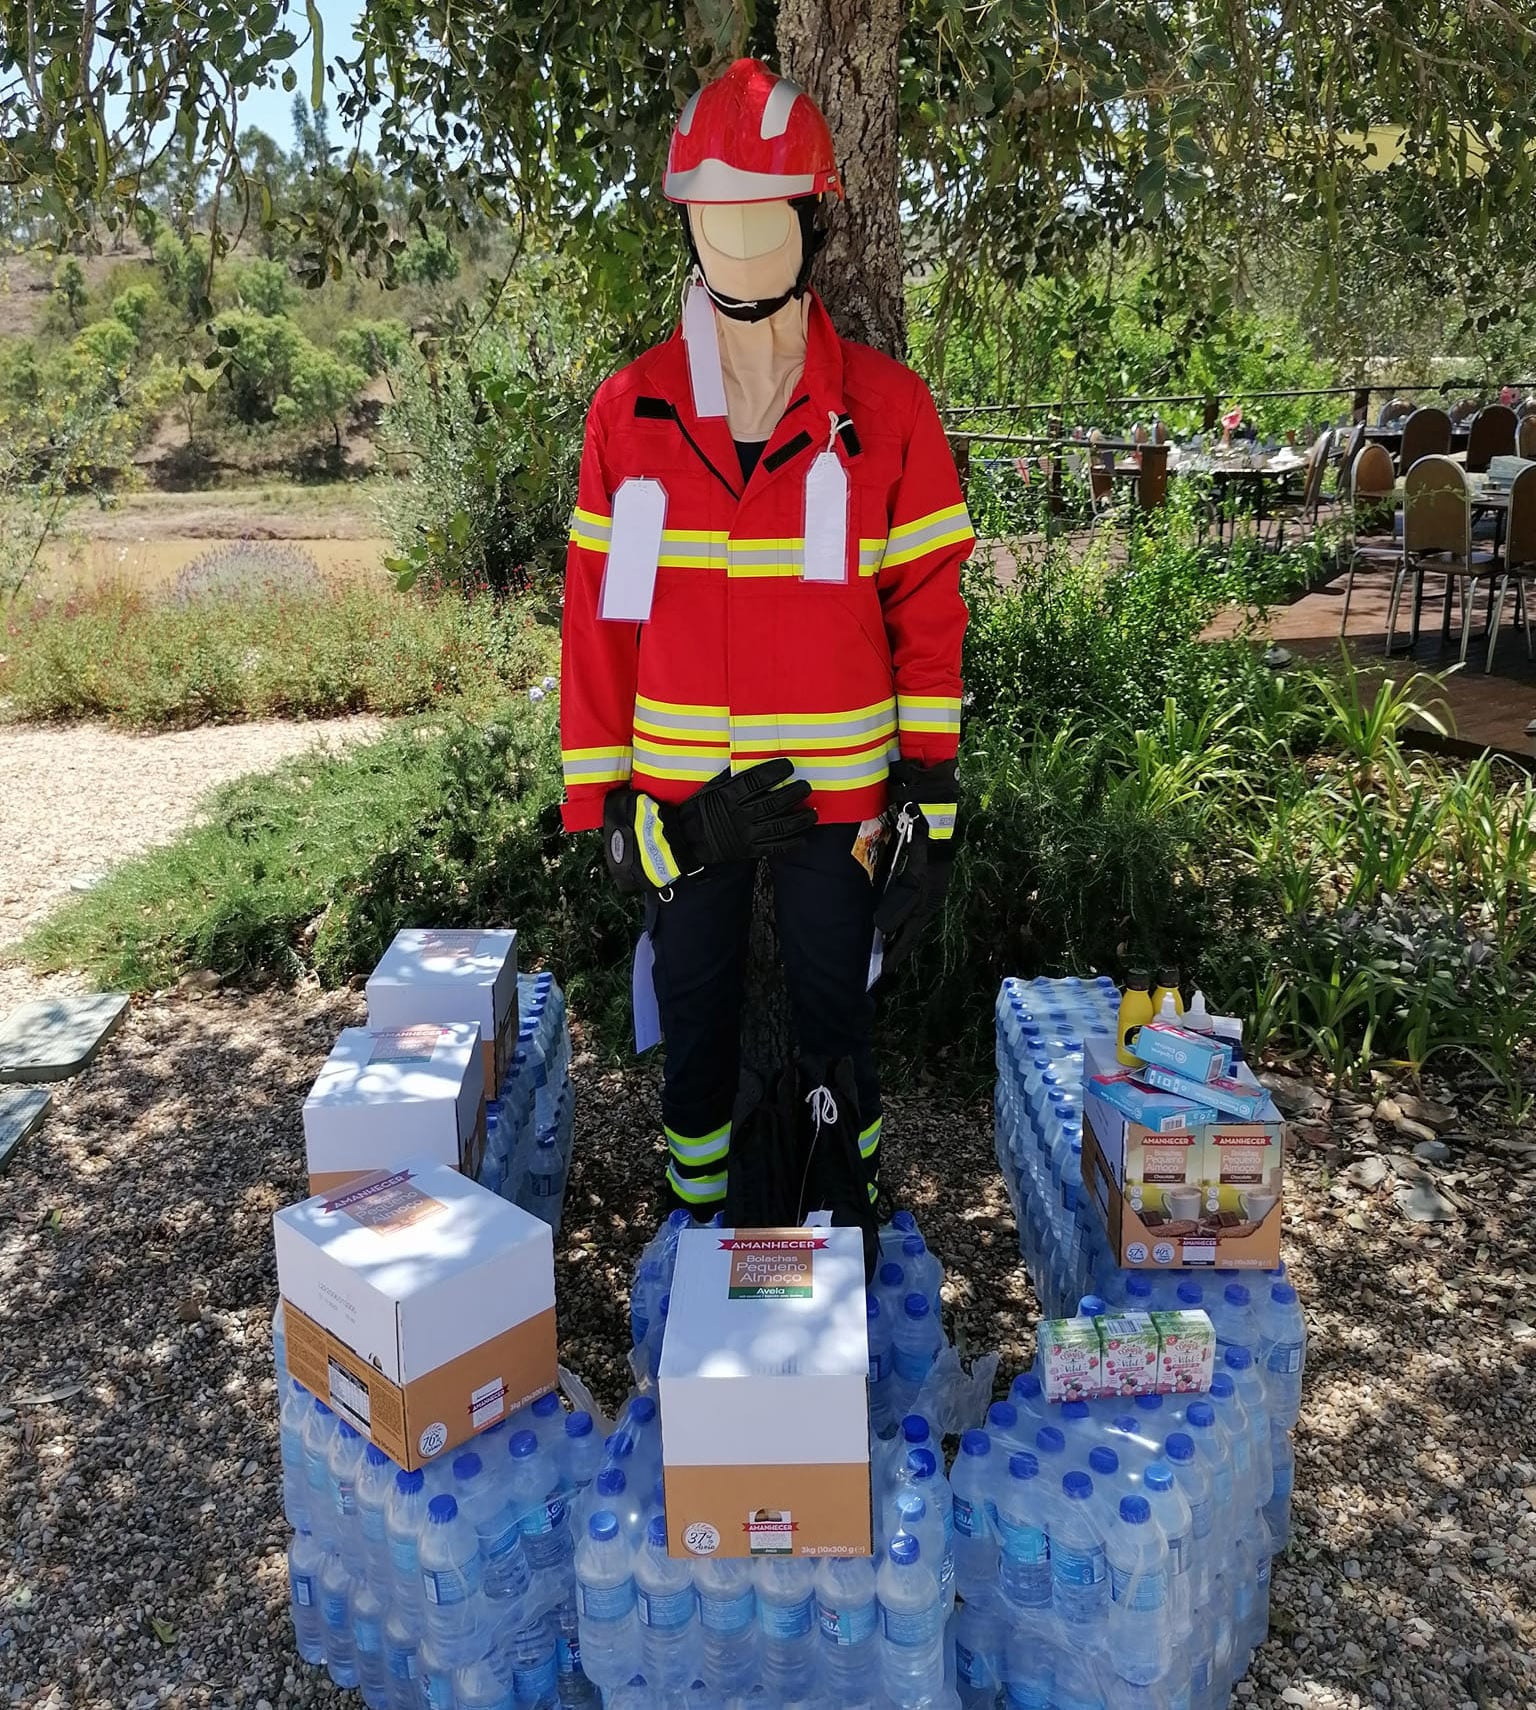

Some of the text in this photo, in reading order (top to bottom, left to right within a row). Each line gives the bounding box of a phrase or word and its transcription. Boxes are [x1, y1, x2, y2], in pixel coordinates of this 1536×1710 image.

[1143, 1137, 1189, 1145] AMANHECER
[334, 1175, 405, 1209] AMANHECER
[356, 1191, 418, 1219] Pequeno
[373, 1199, 424, 1224] Almoço
[731, 1240, 815, 1249] AMANHECER
[746, 1254, 798, 1263] Bolachas
[736, 1262, 808, 1274] Pequeno
[740, 1272, 803, 1284] Almoço
[801, 1546, 816, 1554] 3kg
